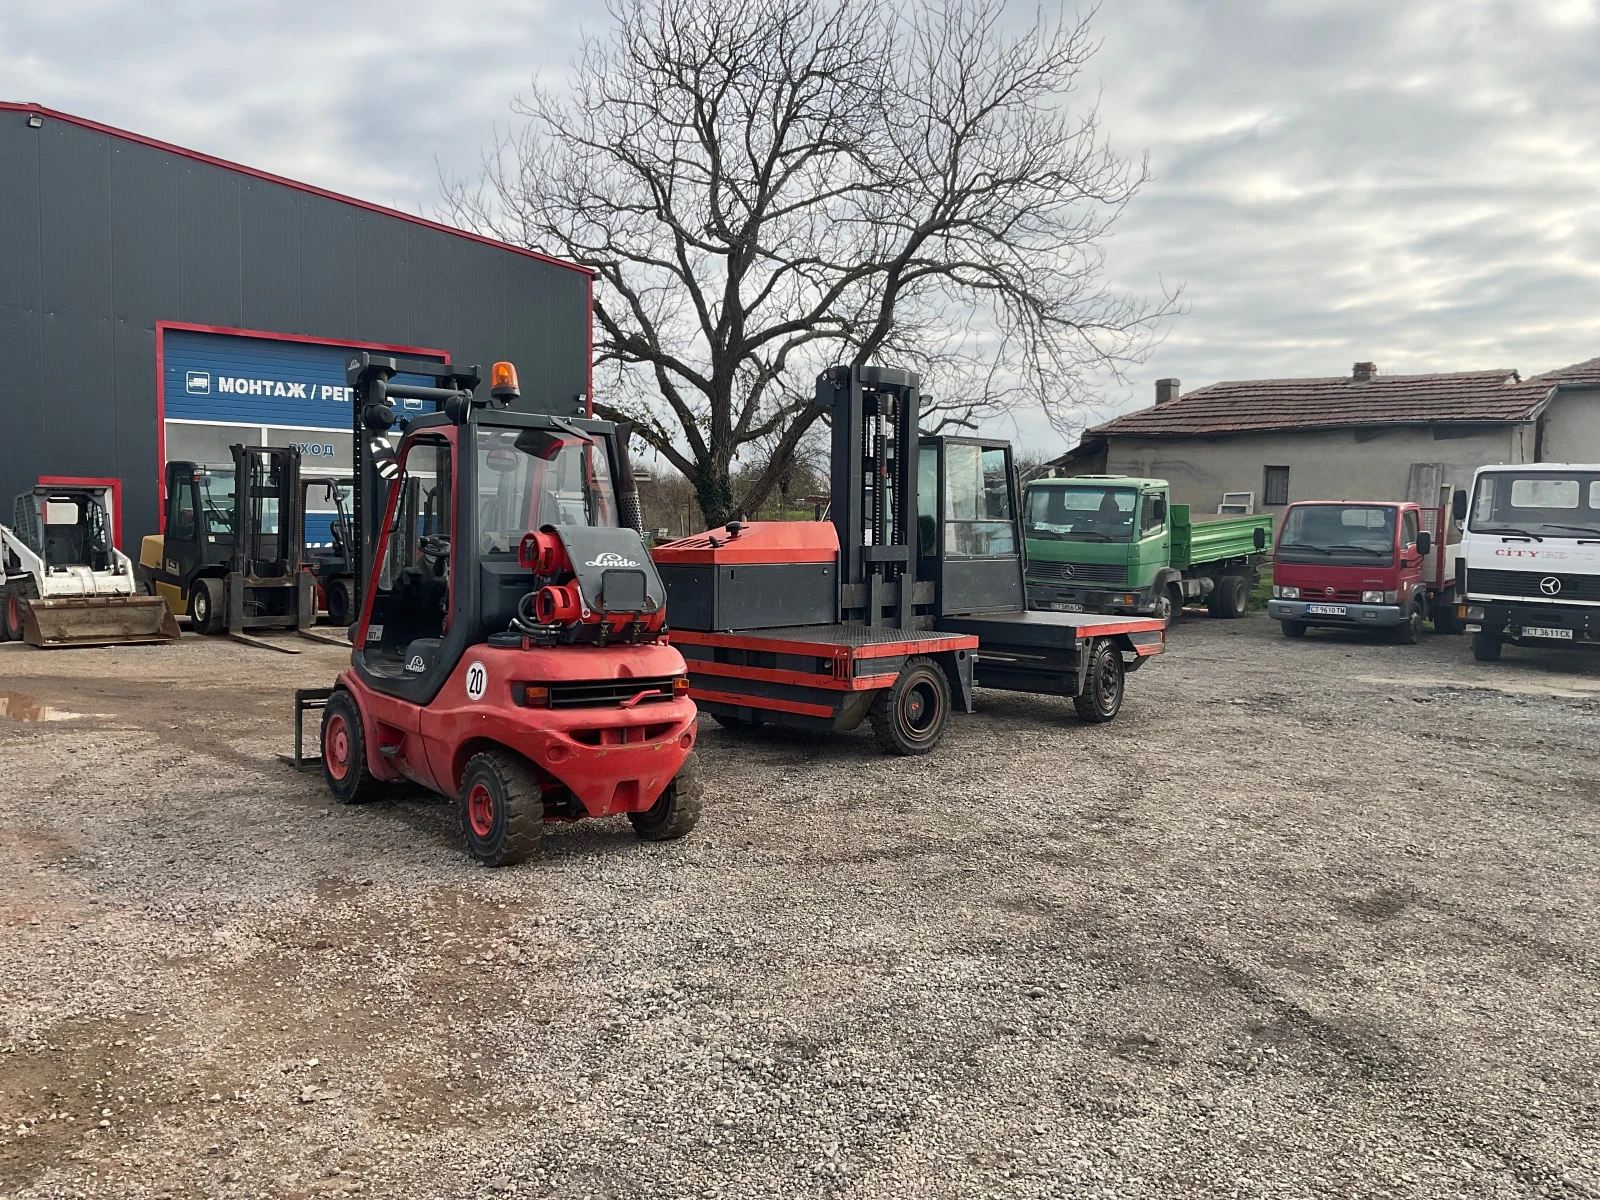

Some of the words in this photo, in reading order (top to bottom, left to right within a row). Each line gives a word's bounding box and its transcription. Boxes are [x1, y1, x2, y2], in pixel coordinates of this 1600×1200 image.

[218, 376, 306, 399] МОНТАЖ
[585, 552, 641, 567] Linde
[1320, 606, 1336, 614] 9610
[1540, 628, 1559, 637] 3611
[1560, 630, 1571, 638] CK
[469, 668, 483, 695] 20
